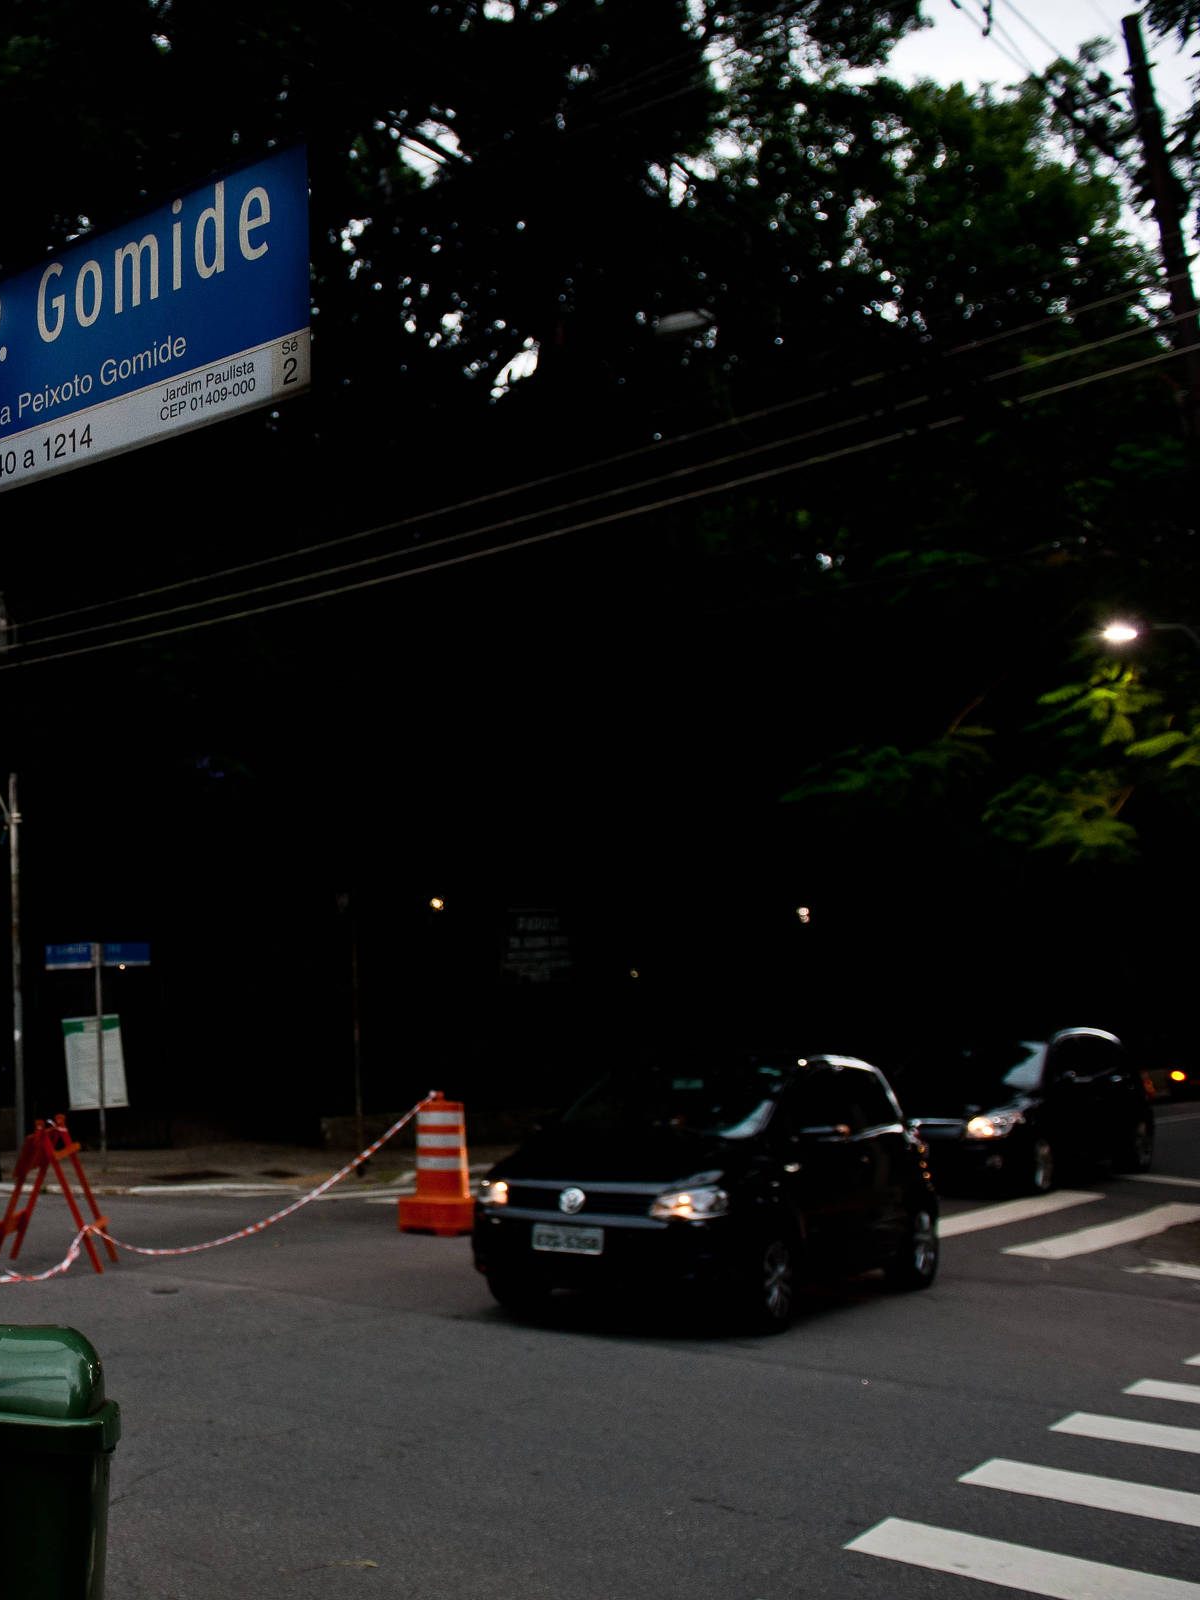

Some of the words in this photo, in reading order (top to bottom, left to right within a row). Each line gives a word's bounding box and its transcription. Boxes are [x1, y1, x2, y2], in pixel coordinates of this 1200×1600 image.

[37, 180, 271, 343] Gomide
[281, 338, 298, 355] Sé
[18, 373, 93, 418] Peixoto
[100, 334, 187, 386] Gomide
[162, 379, 202, 403] Jardim
[205, 360, 255, 390] Paulista
[283, 357, 298, 385] 2
[160, 400, 187, 421] CEP
[190, 378, 256, 411] 01409-000
[23, 449, 35, 468] a
[43, 423, 93, 462] 1214
